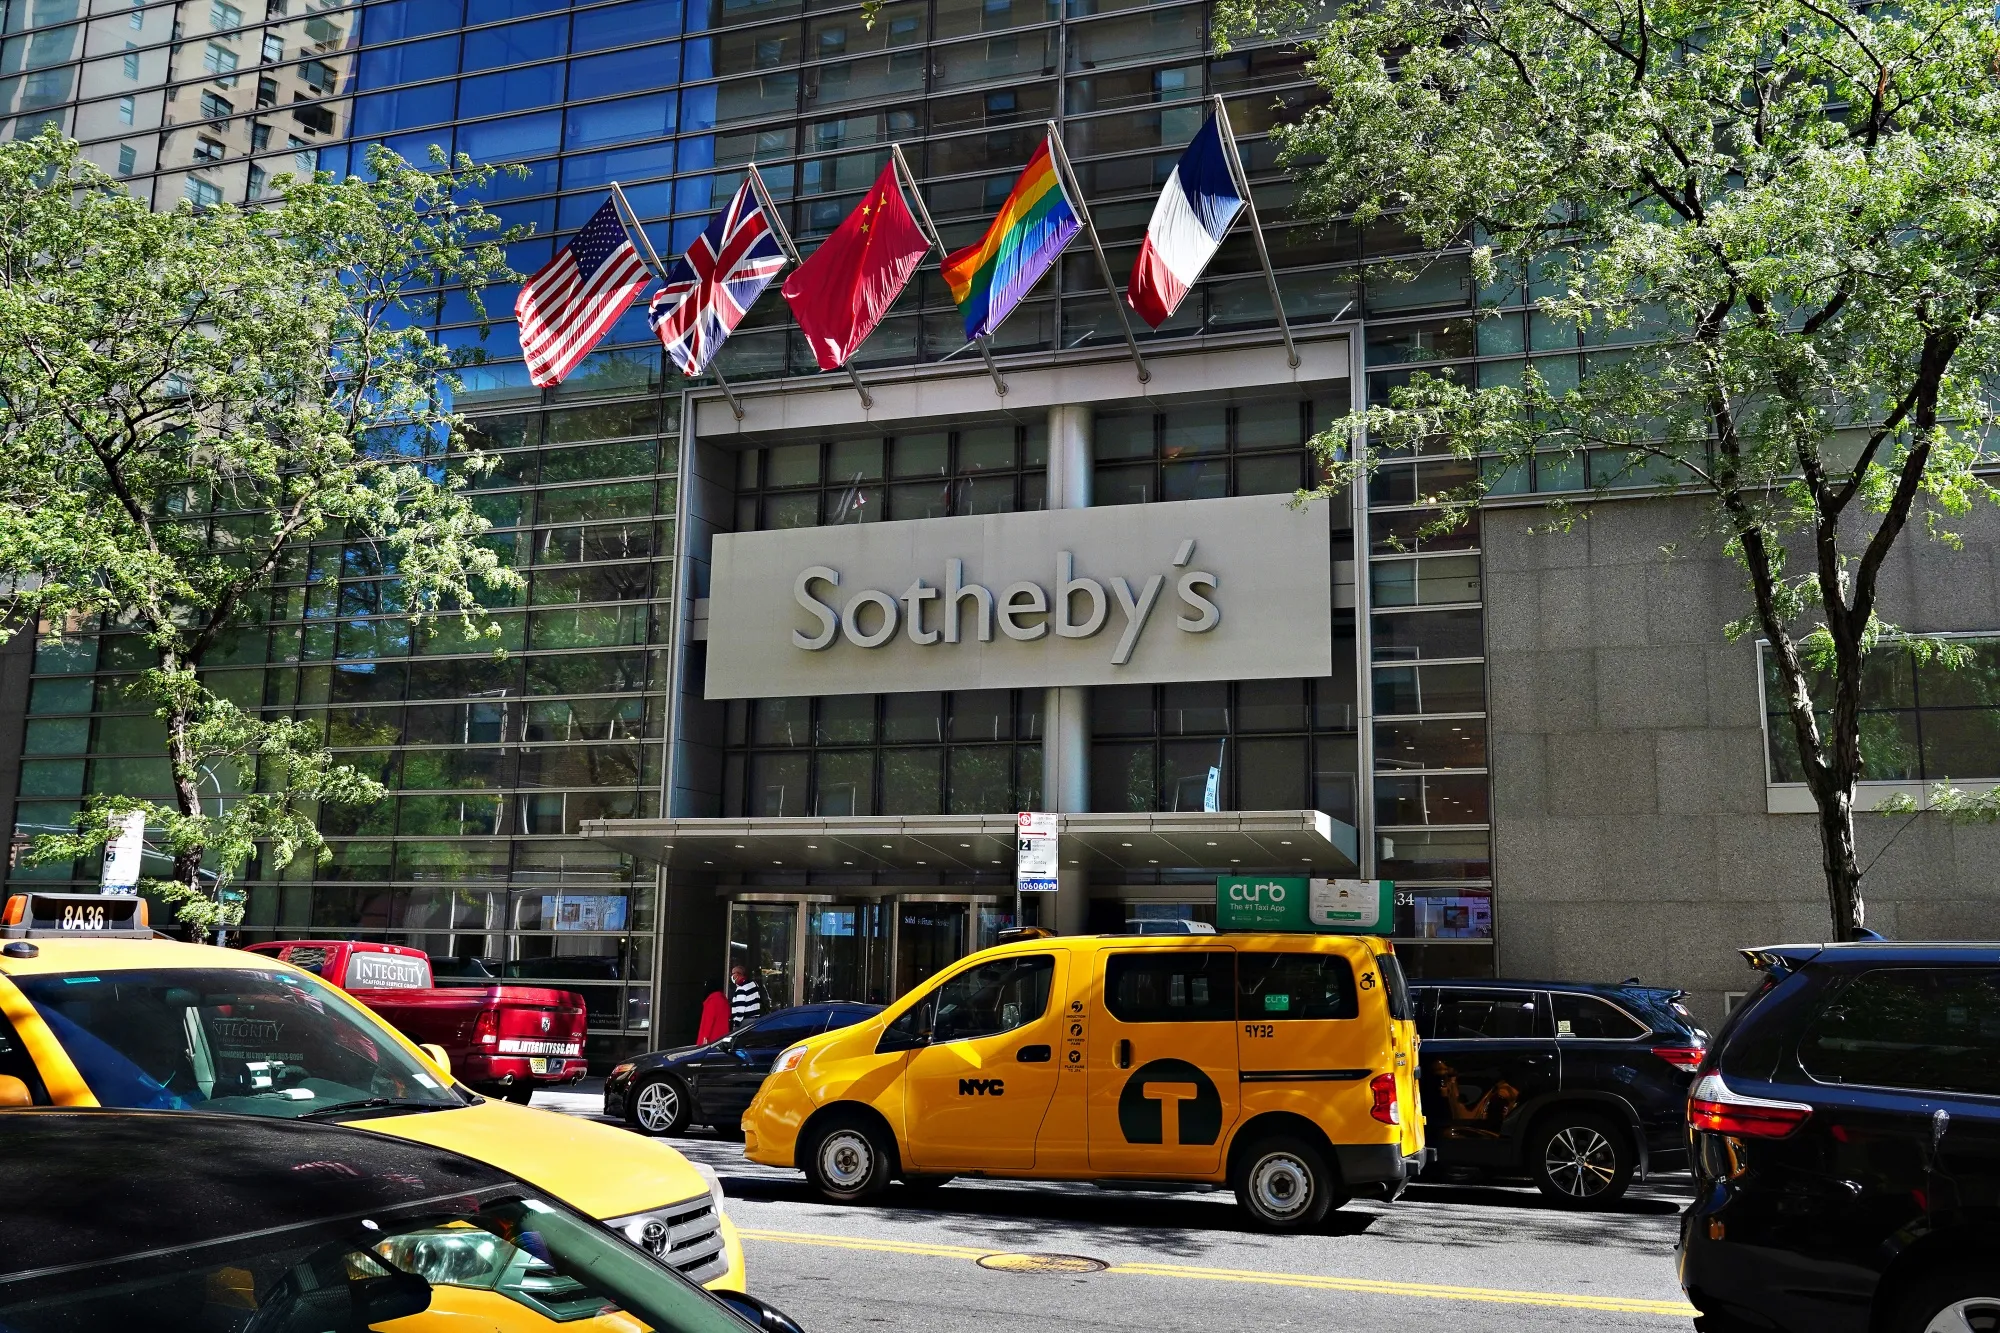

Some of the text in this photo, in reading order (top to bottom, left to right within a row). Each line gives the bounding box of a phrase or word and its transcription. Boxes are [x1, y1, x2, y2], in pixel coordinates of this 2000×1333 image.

[792, 539, 1220, 665] Sotheby's
[1021, 840, 1029, 850] 2
[107, 852, 114, 861] 2
[1229, 882, 1285, 902] curb
[1394, 893, 1414, 906] 34
[1270, 904, 1285, 912] App
[62, 905, 104, 930] 8A36
[356, 958, 425, 987] INTEGRITY
[1265, 996, 1289, 1004] curb
[213, 1022, 284, 1041] NTEGRITY
[1245, 1025, 1274, 1038] 9Y32
[499, 1039, 580, 1055] WWW.INTEGRITYSSG.COM
[959, 1078, 1005, 1096] NYC
[1143, 1082, 1197, 1145] T
